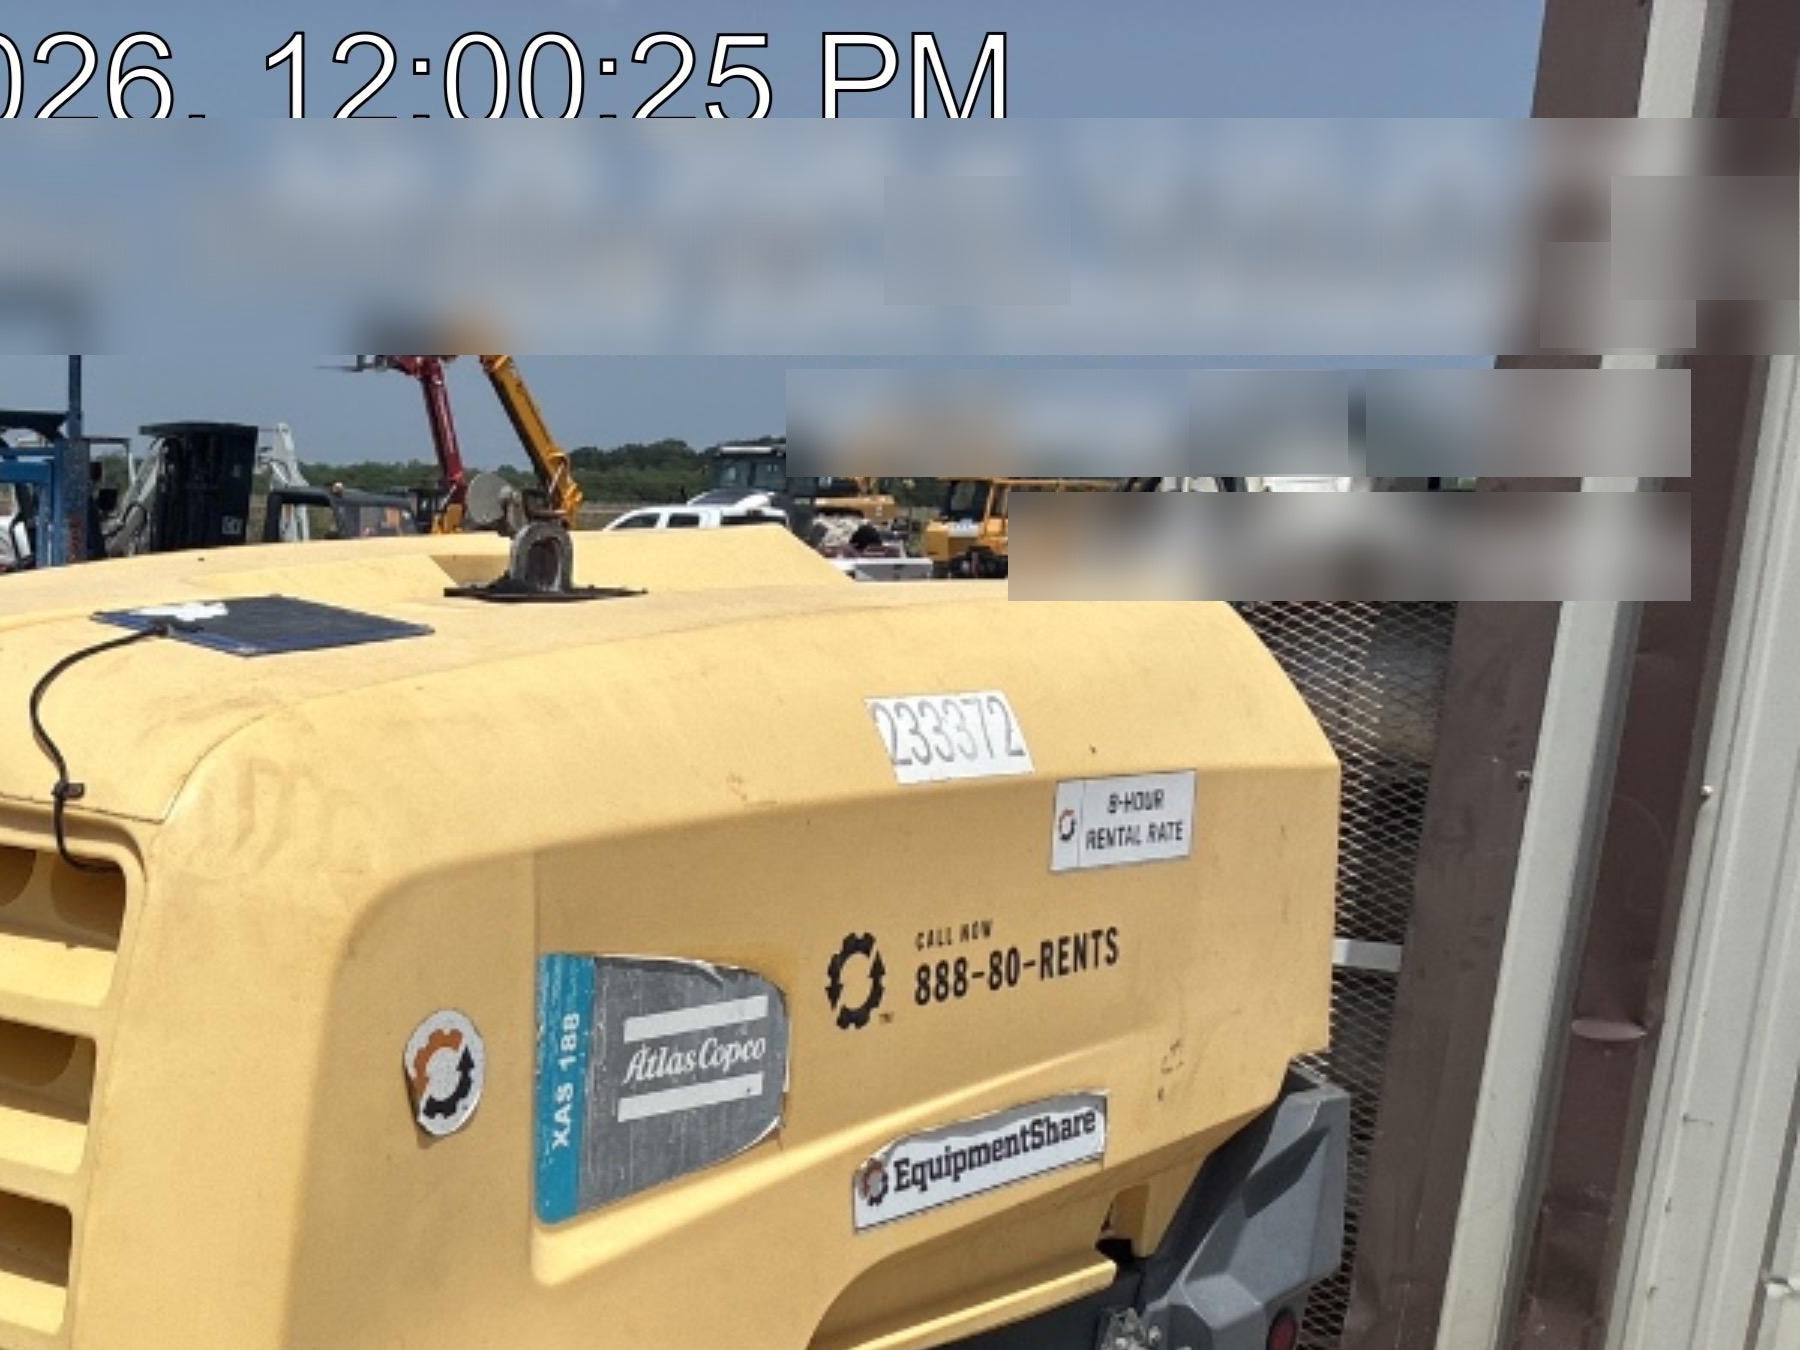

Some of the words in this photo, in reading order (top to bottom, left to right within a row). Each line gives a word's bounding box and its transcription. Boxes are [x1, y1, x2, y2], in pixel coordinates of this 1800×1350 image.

[869, 695, 1026, 766] 233372
[1107, 788, 1165, 814] 8-HOUR
[1085, 825, 1141, 850] RENTAL
[1146, 819, 1184, 844] RATE
[914, 925, 952, 952] CALL
[959, 918, 994, 943] NOW
[914, 925, 1120, 1006] 888-80-RENTS
[621, 1045, 698, 1084] Atlas
[697, 1036, 767, 1074] Copco
[551, 1081, 575, 1150] XAS
[893, 1108, 1097, 1193] EquipmentShare
